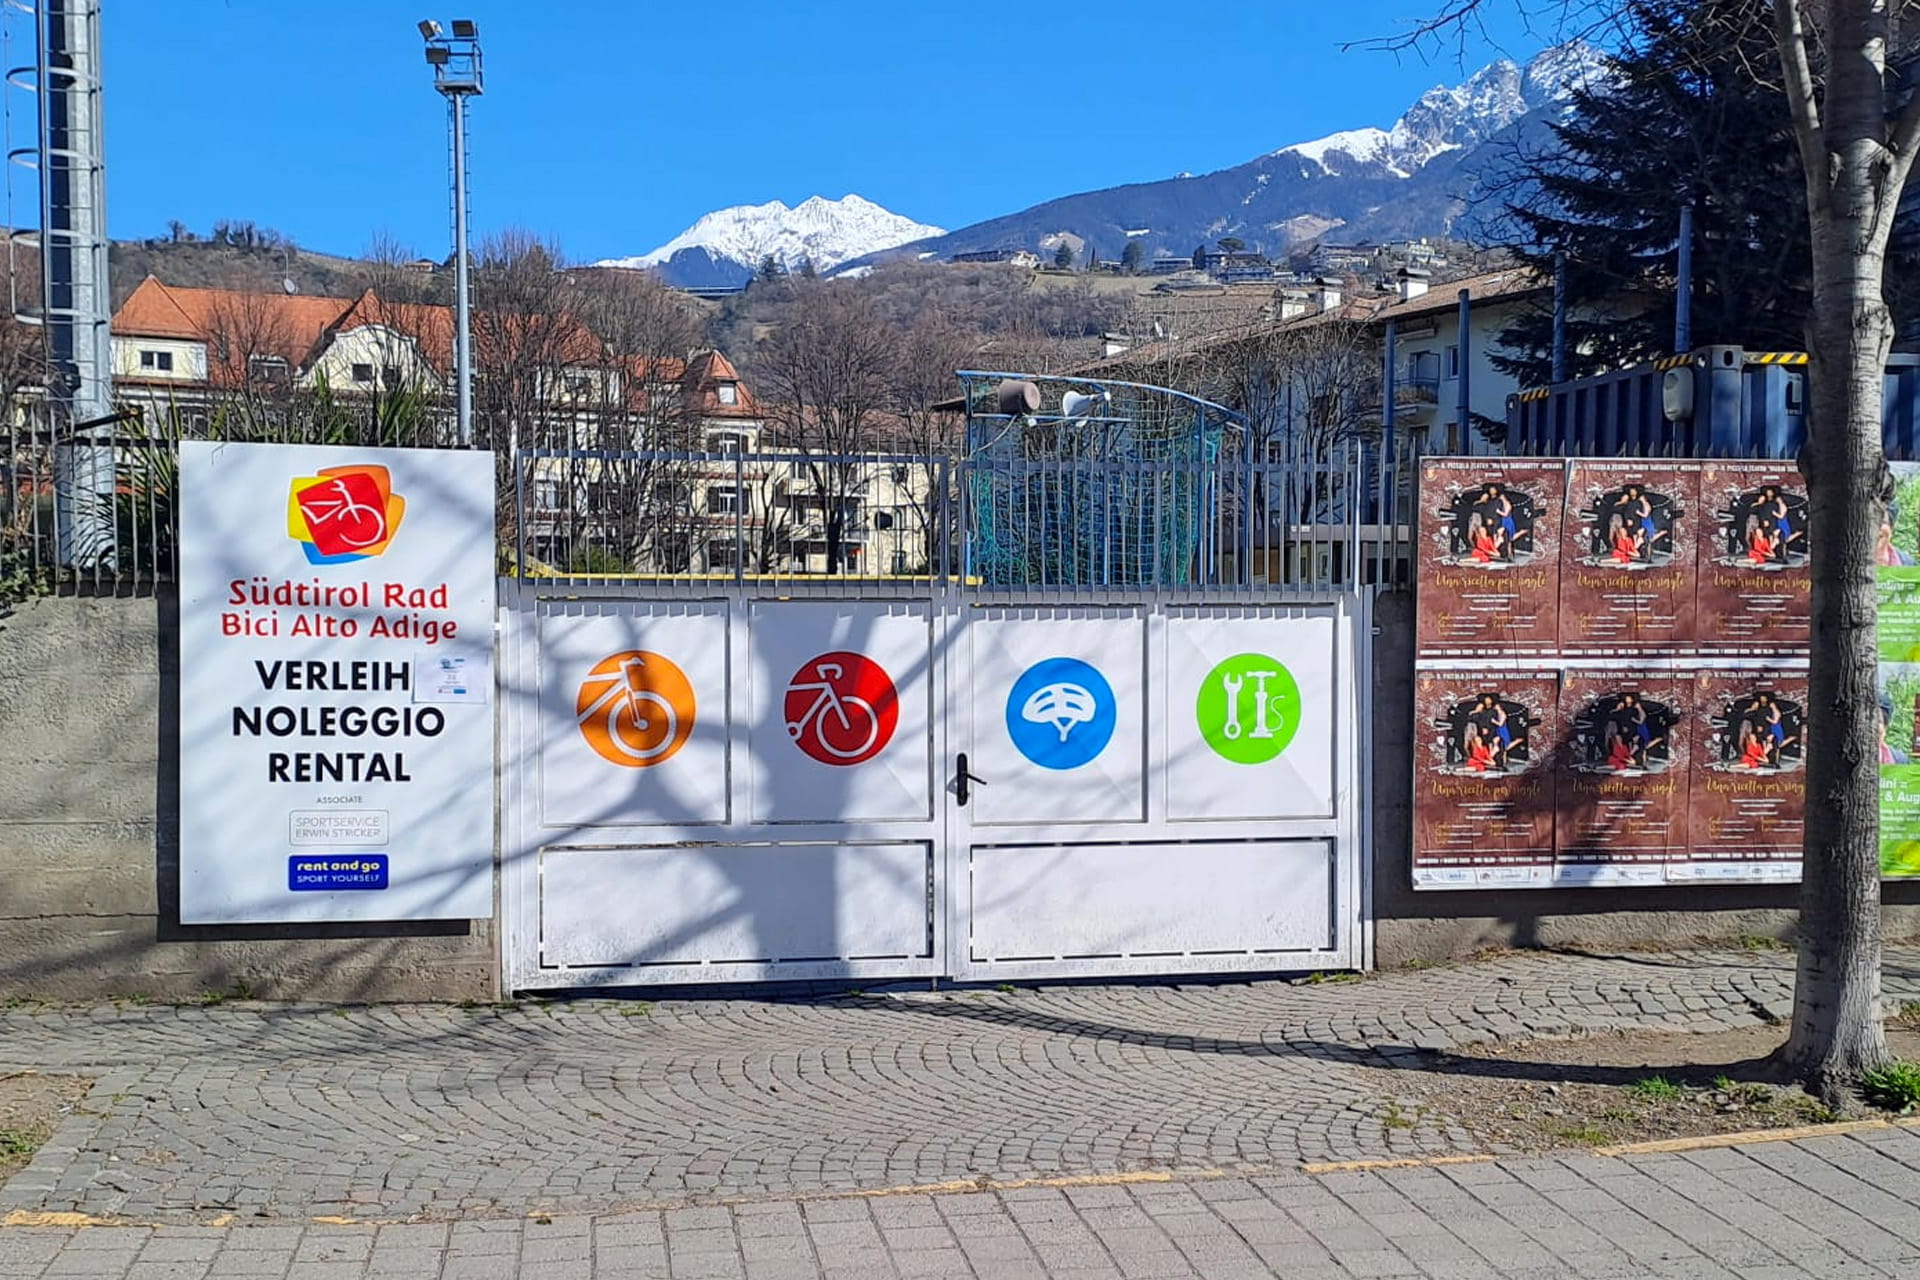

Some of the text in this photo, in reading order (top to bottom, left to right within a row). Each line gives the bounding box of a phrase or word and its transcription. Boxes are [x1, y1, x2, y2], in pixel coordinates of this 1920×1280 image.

[1792, 577, 1812, 592] sing
[228, 576, 449, 609] Südtirol Rad
[221, 609, 458, 644] Bici Alto Adige
[254, 660, 409, 691] VERLEIH
[233, 706, 445, 737] NOLEGGIO
[269, 753, 411, 782] RENTAL
[1784, 782, 1804, 793] sing
[316, 796, 363, 804] ASSOCIATE
[295, 817, 380, 828] SPORTSERVICE
[295, 828, 380, 838] ERWIN STRICKER
[297, 861, 328, 871] rent
[361, 862, 380, 873] go
[297, 874, 380, 883] SPORT YOURSELF
